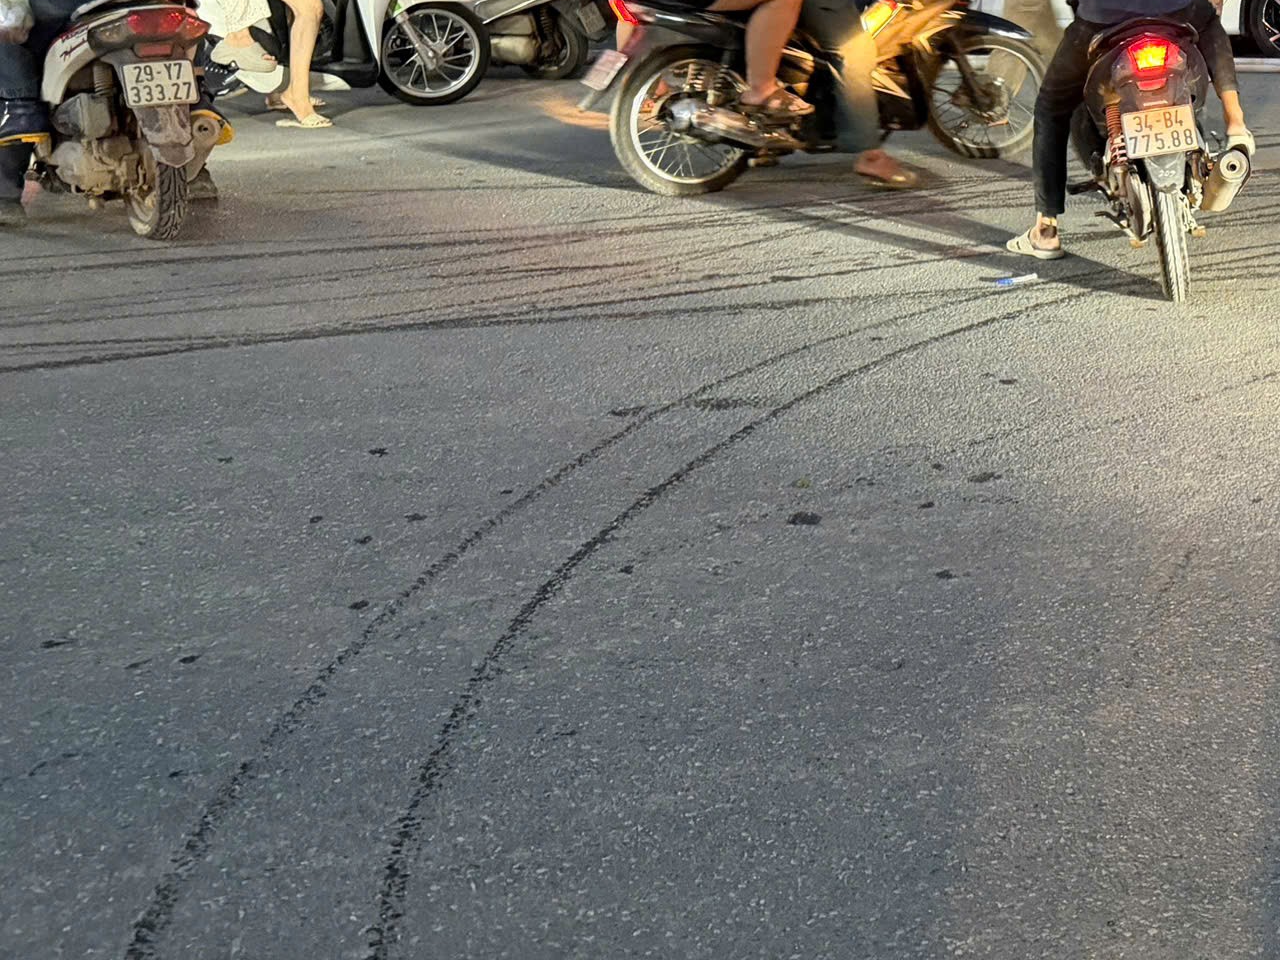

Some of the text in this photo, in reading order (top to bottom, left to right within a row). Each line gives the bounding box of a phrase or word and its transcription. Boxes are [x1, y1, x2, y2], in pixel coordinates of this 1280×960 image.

[133, 62, 184, 84] 29-Y7
[130, 82, 193, 104] 333.27
[1132, 109, 1184, 133] 34-B4
[1128, 128, 1194, 155] 775.88
